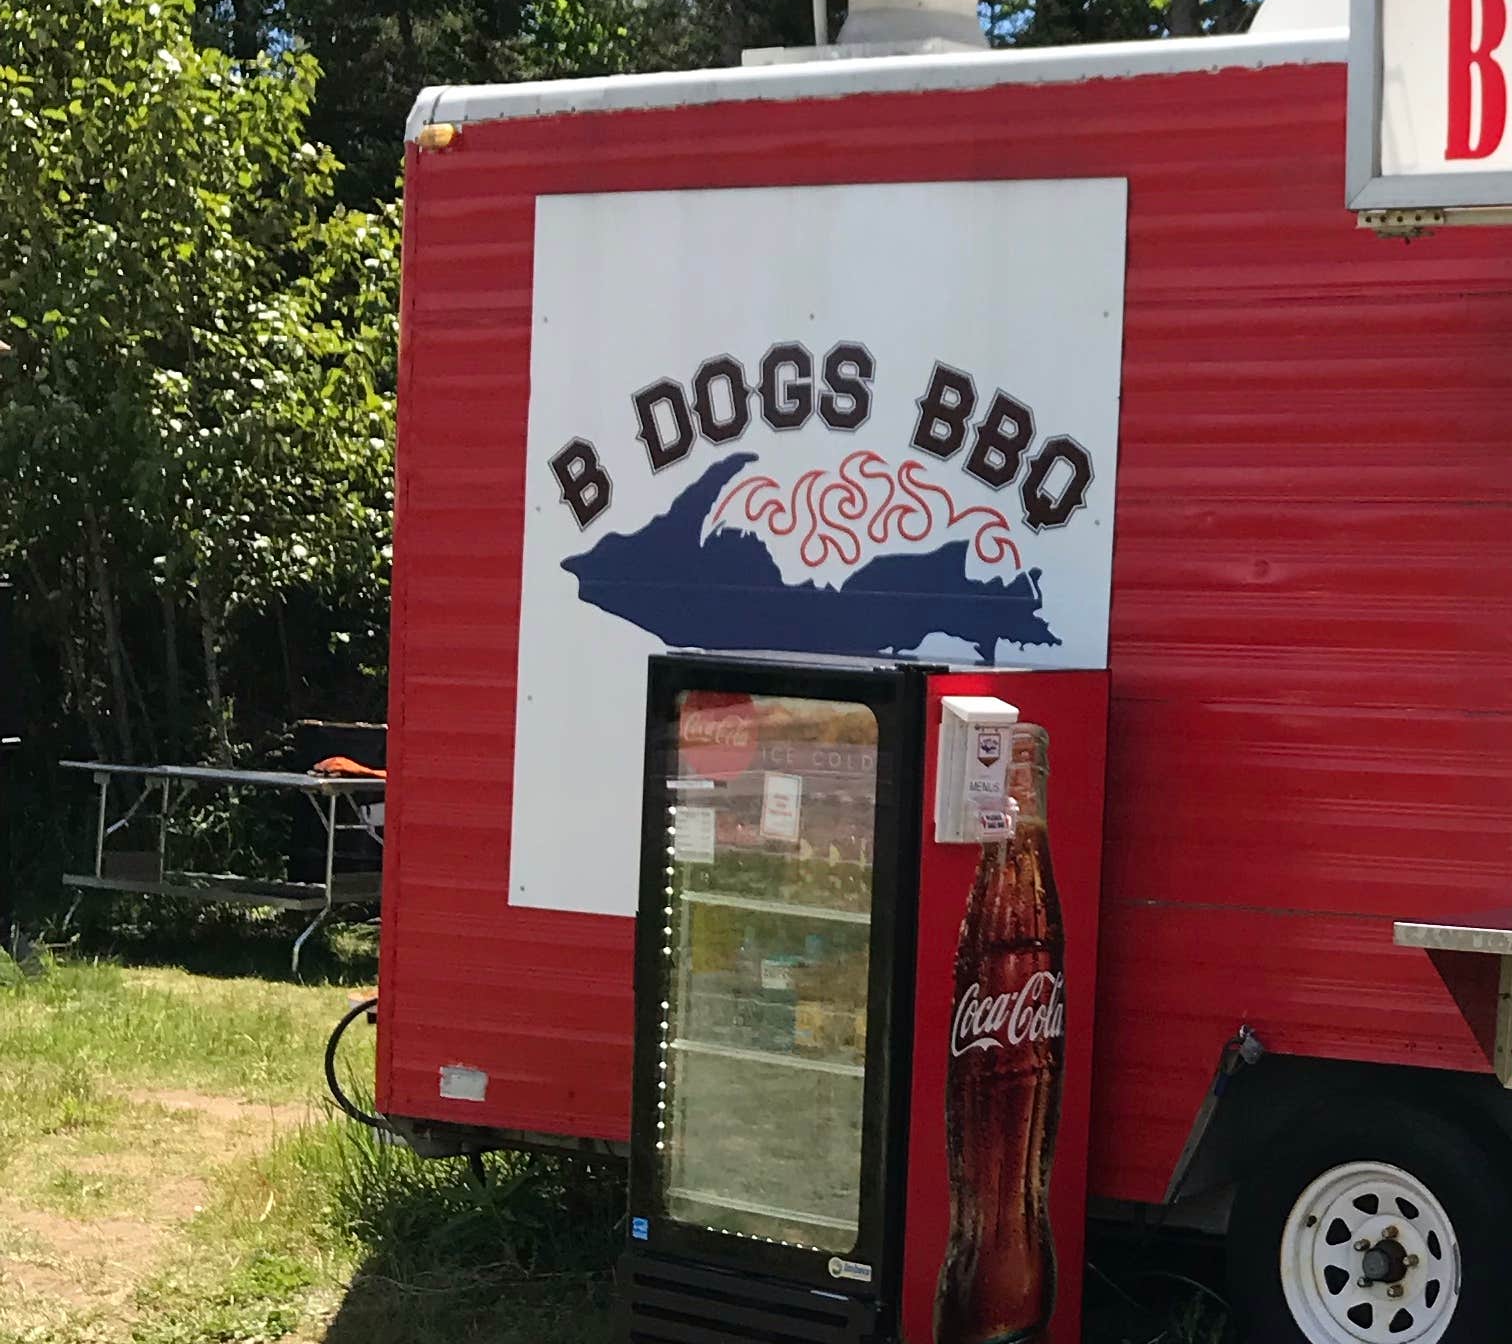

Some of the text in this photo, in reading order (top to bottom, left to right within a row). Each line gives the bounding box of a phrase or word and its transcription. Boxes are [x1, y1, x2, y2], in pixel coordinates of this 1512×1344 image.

[548, 340, 1095, 534] B DOGS BBQ
[951, 971, 1064, 1056] Coca-Cola
